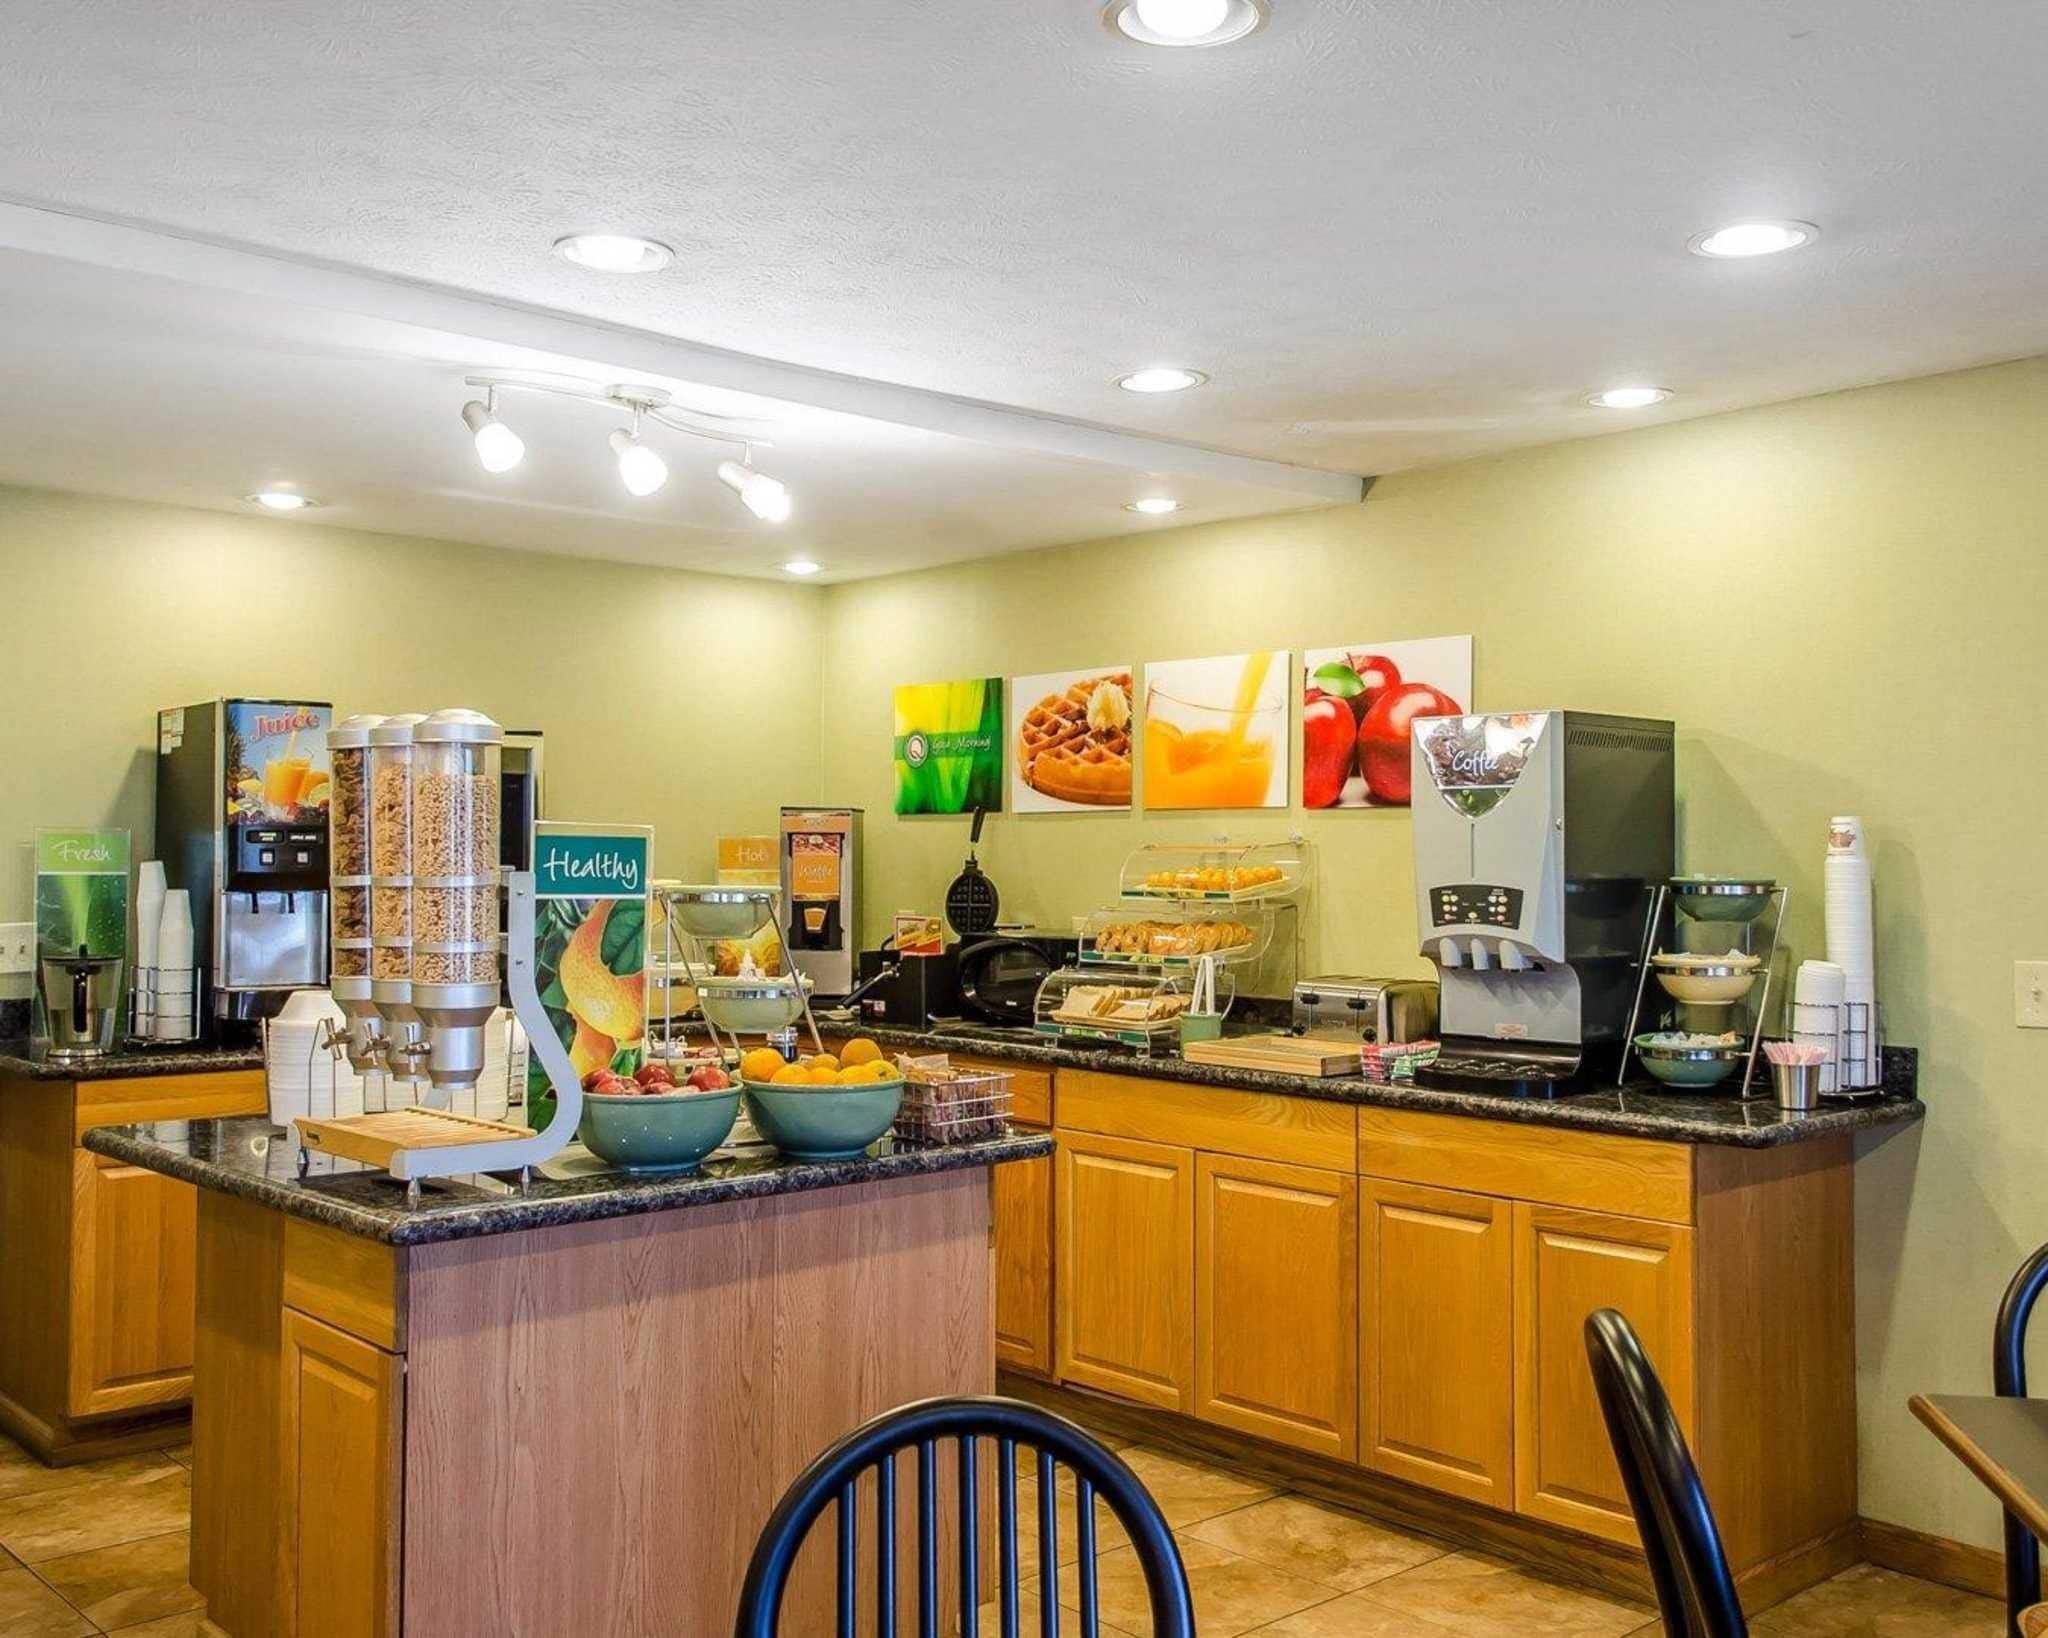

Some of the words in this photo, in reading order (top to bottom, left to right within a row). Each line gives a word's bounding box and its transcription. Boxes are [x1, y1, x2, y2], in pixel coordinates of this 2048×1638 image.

[252, 712, 319, 741] Juice
[1453, 750, 1500, 776] Coffee
[51, 840, 112, 862] Fresh
[736, 845, 768, 863] Hot
[543, 848, 637, 889] Healthy
